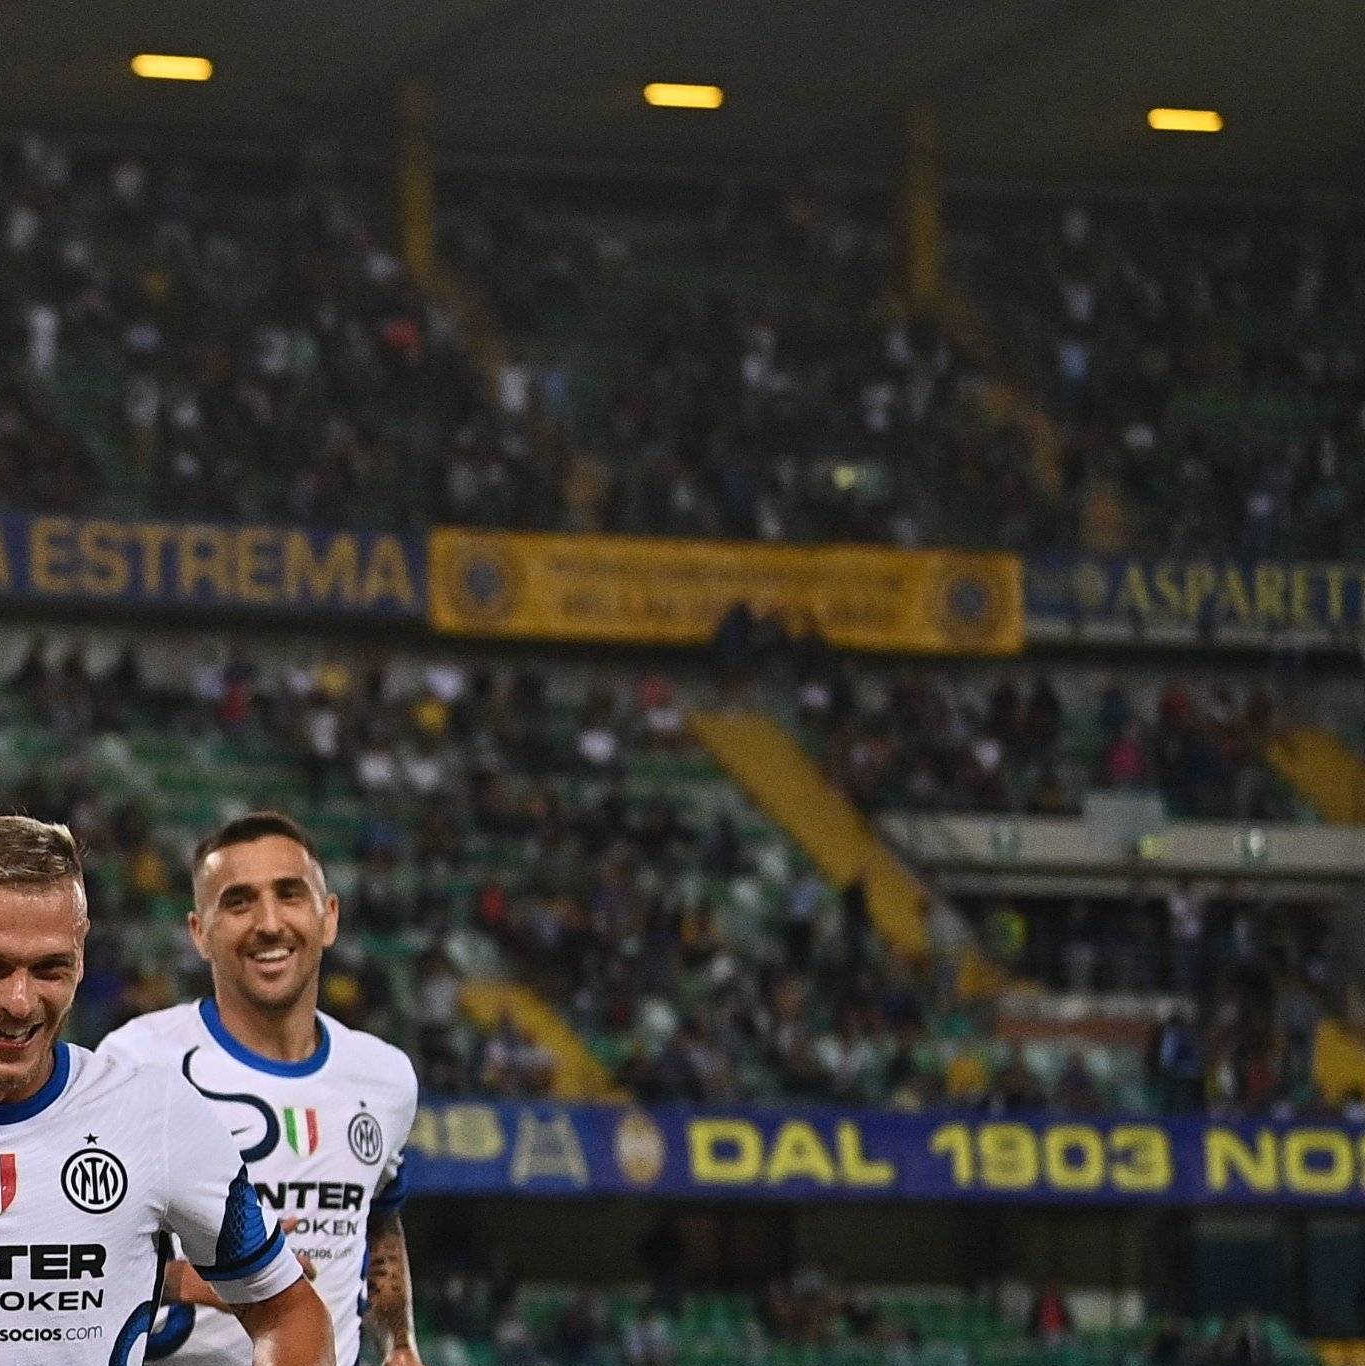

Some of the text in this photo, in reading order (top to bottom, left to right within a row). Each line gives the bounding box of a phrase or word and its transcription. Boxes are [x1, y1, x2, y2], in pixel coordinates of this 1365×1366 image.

[30, 516, 416, 609] ESTREMA
[1119, 559, 1365, 622] ASPARET
[687, 1116, 1365, 1192] DAL 1903 NO
[254, 1182, 365, 1211] NTER
[293, 1217, 358, 1236] OKEN
